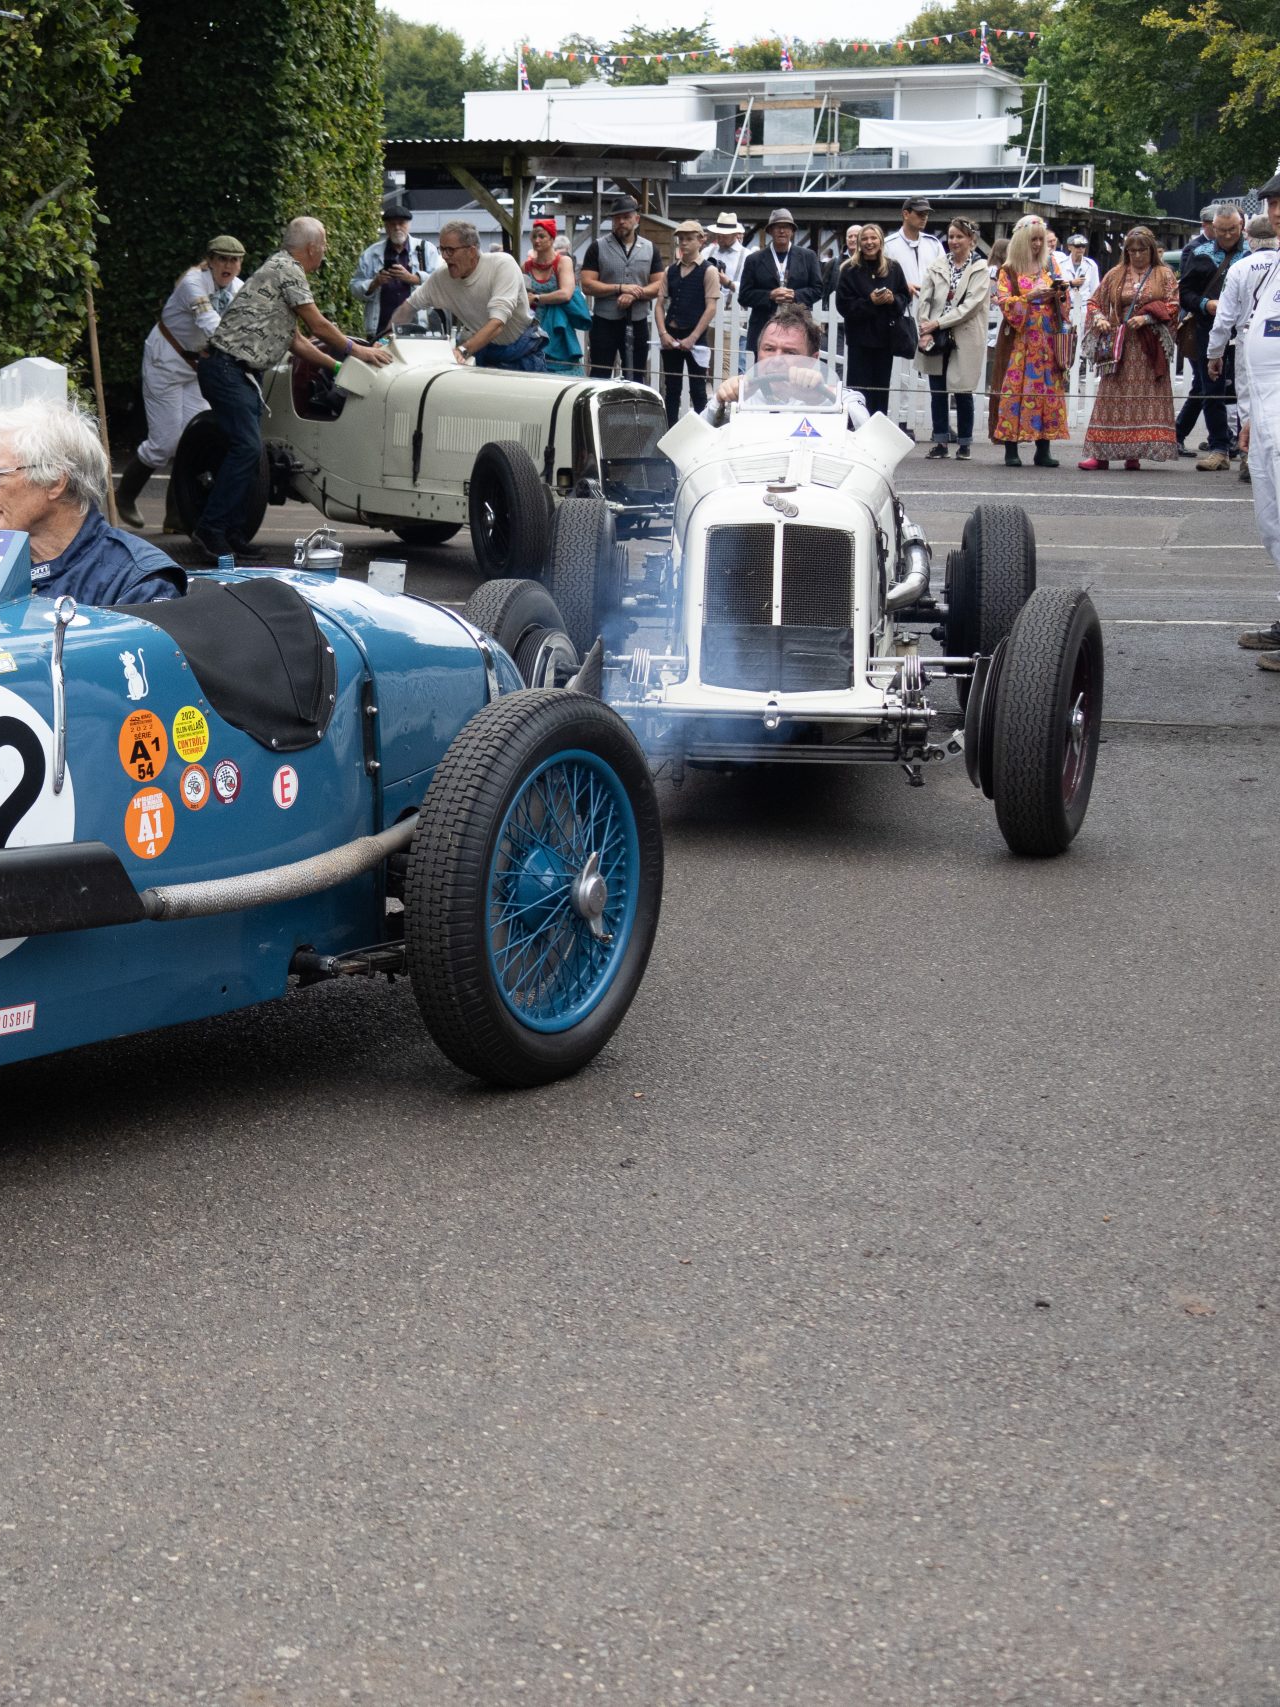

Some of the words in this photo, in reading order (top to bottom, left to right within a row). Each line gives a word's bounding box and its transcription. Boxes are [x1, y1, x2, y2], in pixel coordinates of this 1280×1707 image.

[531, 204, 546, 216] 34
[181, 711, 195, 721] 2022
[137, 762, 155, 780] 54
[280, 770, 292, 804] E
[138, 810, 164, 843] A1
[146, 841, 156, 856] 4
